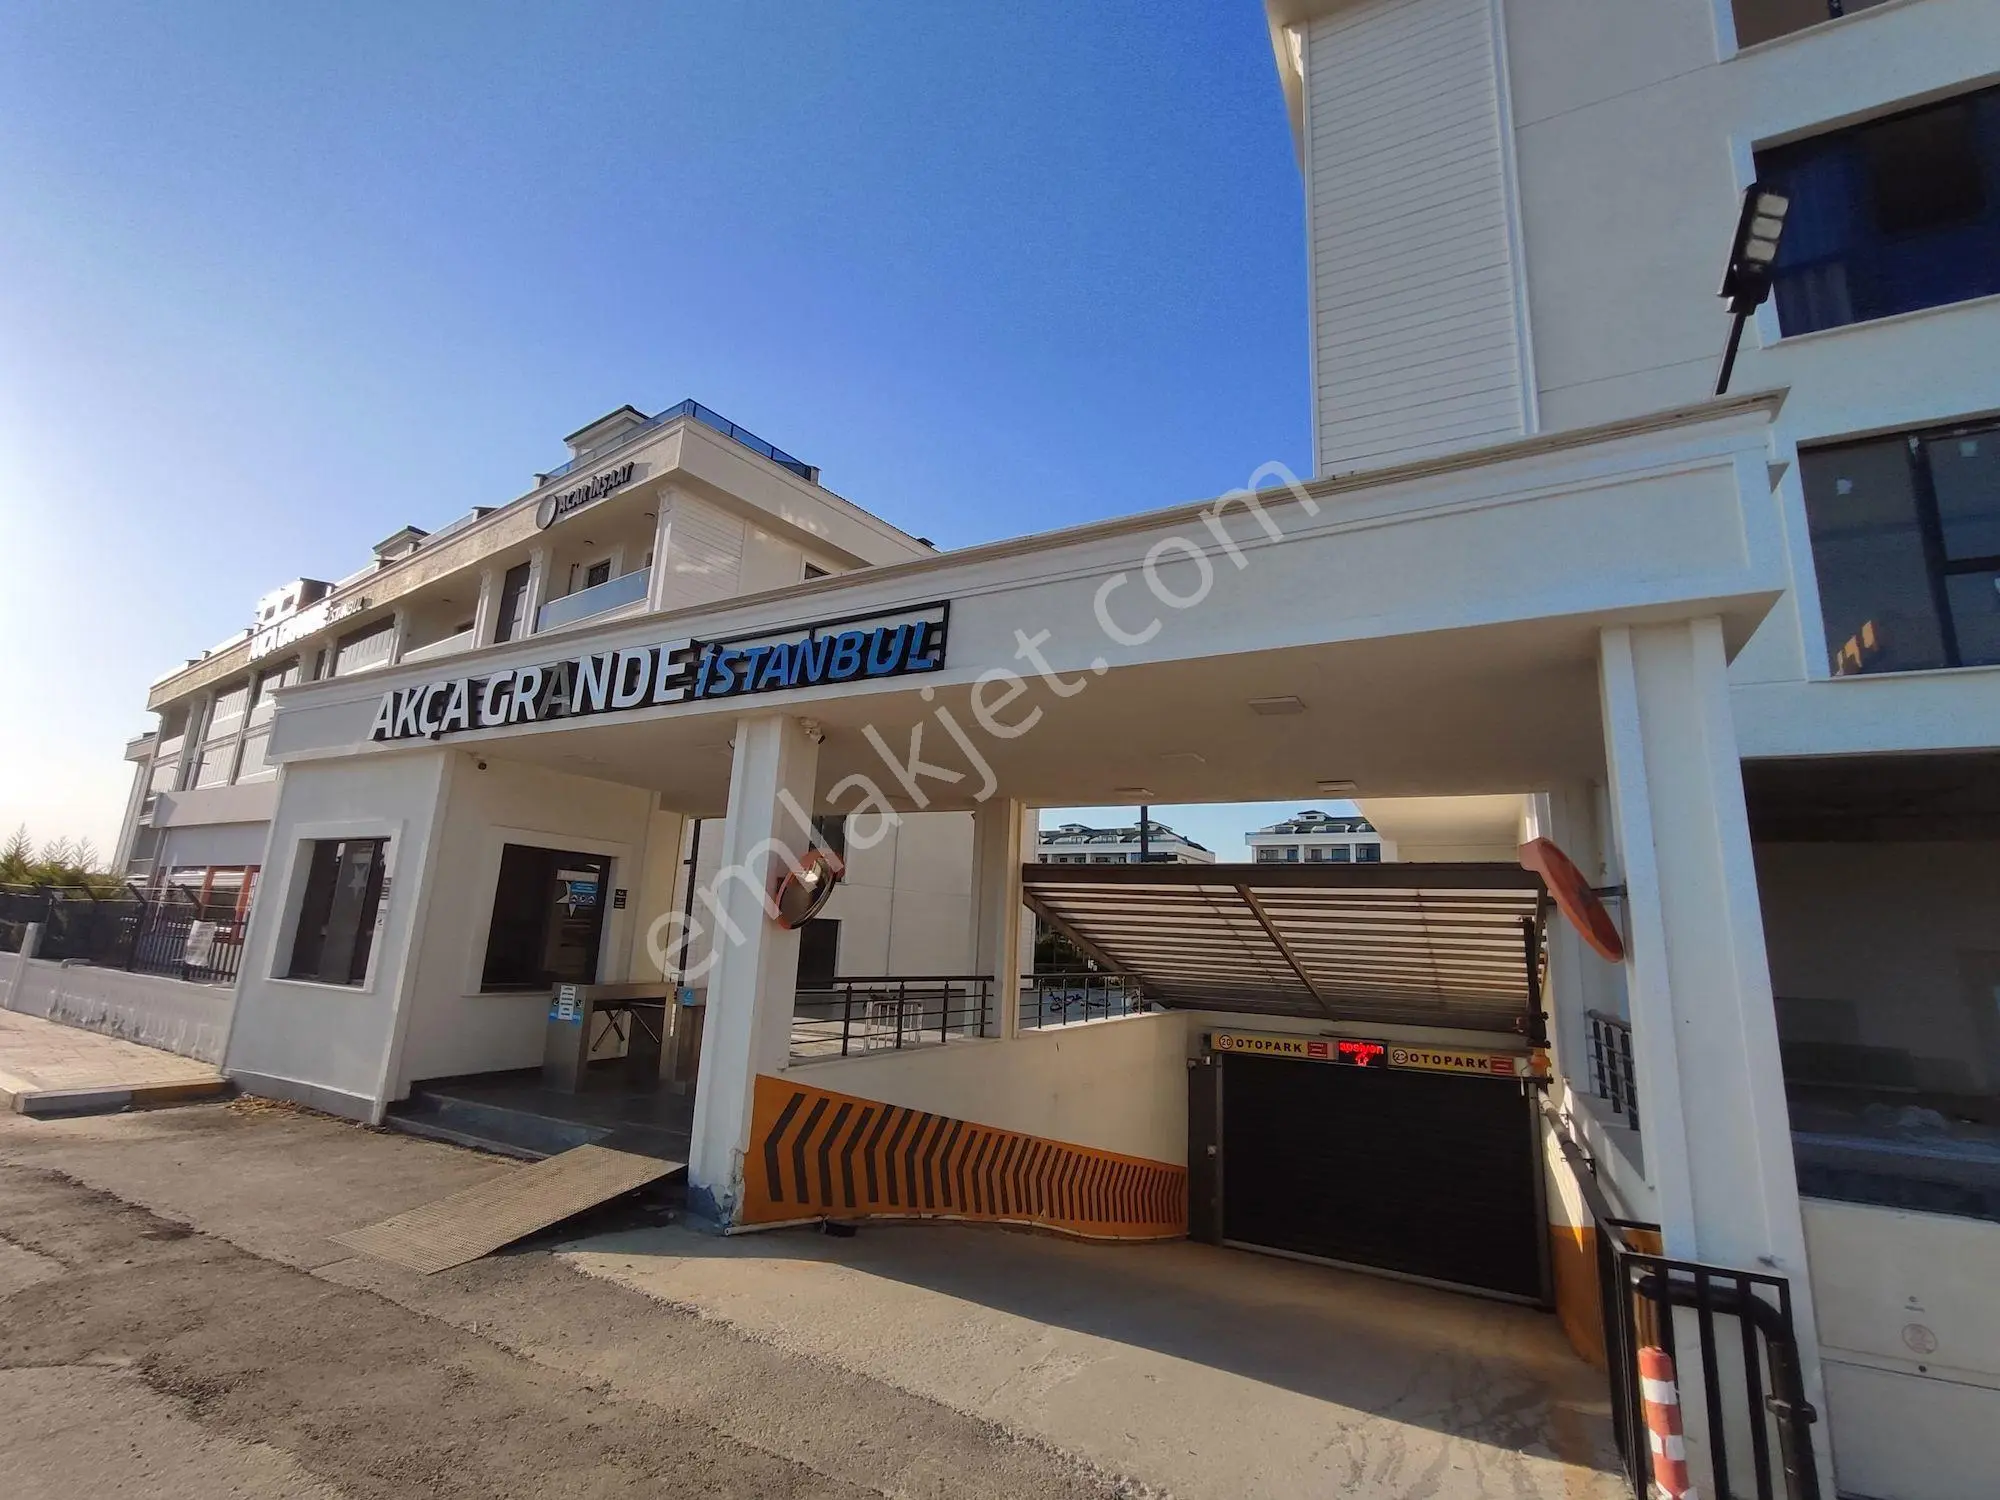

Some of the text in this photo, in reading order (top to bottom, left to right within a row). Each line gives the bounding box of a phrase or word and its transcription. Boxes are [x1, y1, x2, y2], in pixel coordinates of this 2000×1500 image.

[559, 461, 634, 514] ACAR İNŞAAT
[367, 621, 936, 740] AKÇA GRANDE İSTANBUL
[1236, 1039, 1302, 1054] OTOPARK
[1410, 1053, 1488, 1069] OTOPARK
